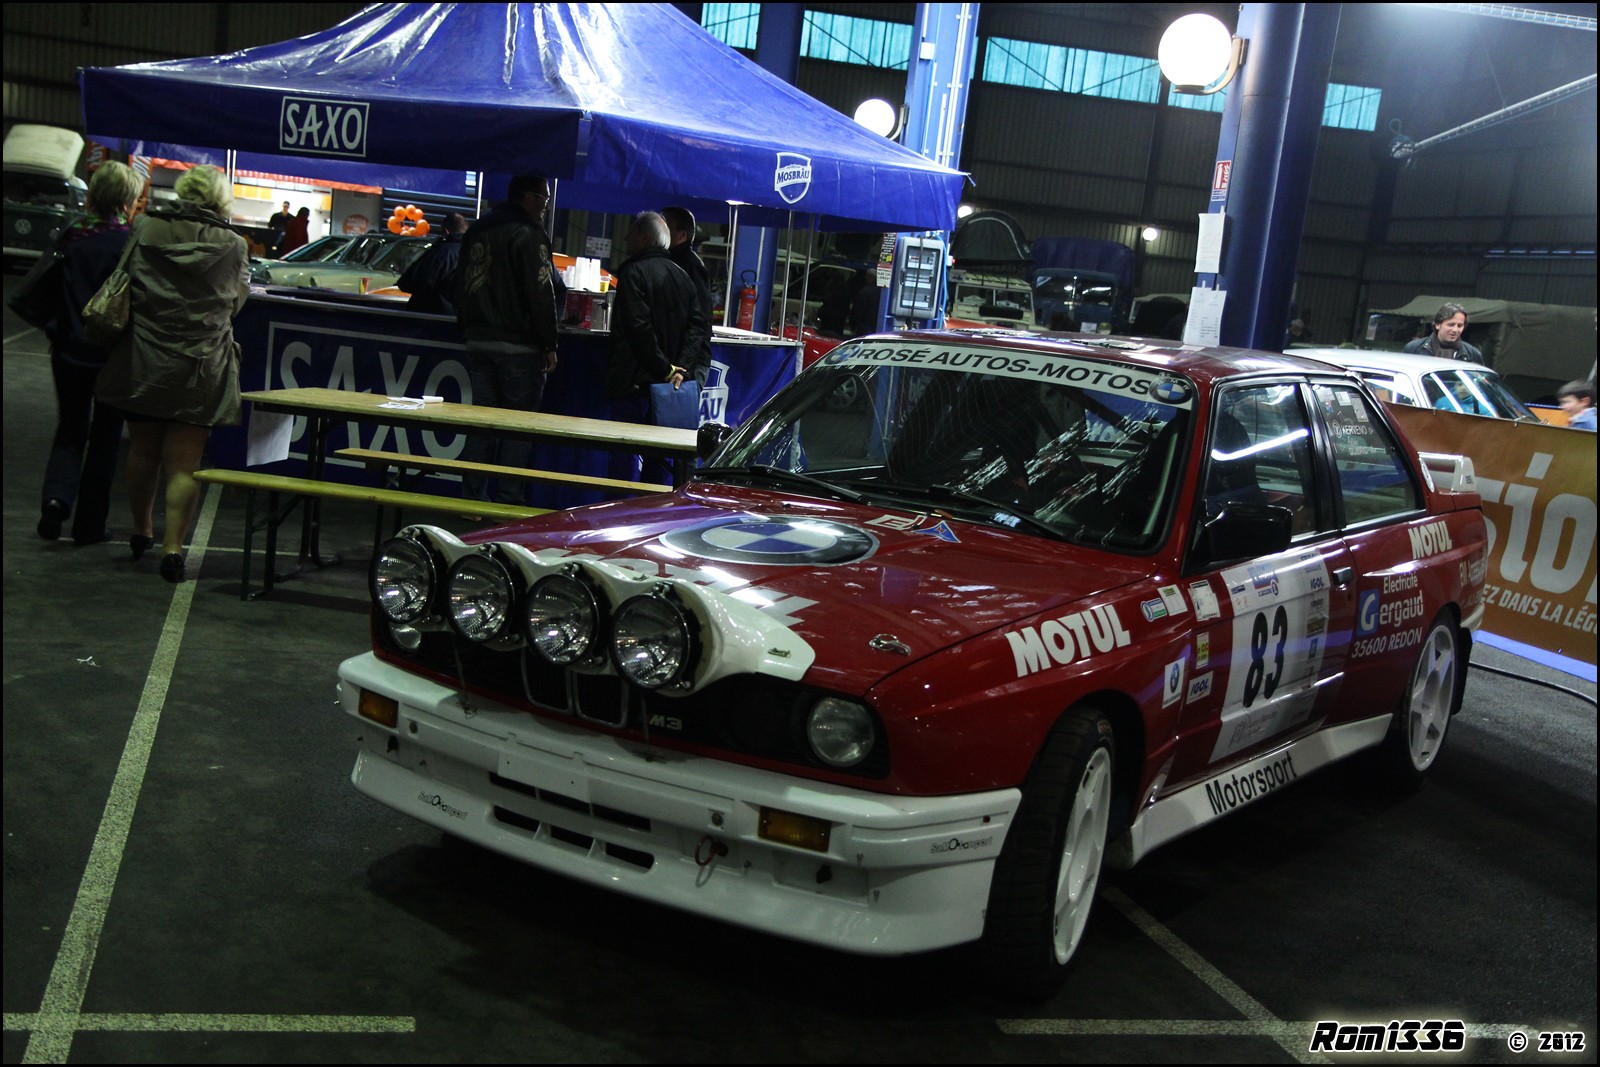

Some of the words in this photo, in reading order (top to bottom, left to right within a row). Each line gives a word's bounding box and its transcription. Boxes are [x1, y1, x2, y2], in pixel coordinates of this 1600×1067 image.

[284, 103, 363, 150] SAXO
[934, 349, 1151, 395] AUTOS-MOTOS
[1408, 521, 1452, 560] MOTUL
[1361, 590, 1424, 631] Gergaud
[1499, 589, 1542, 616] DANS
[1541, 600, 1564, 623] LA
[1004, 604, 1131, 678] MOTUL
[1243, 605, 1287, 708] 83
[1351, 636, 1387, 659] 35600
[1388, 627, 1423, 651] REDON
[649, 713, 683, 731] M3
[1205, 751, 1297, 815] Motorsport
